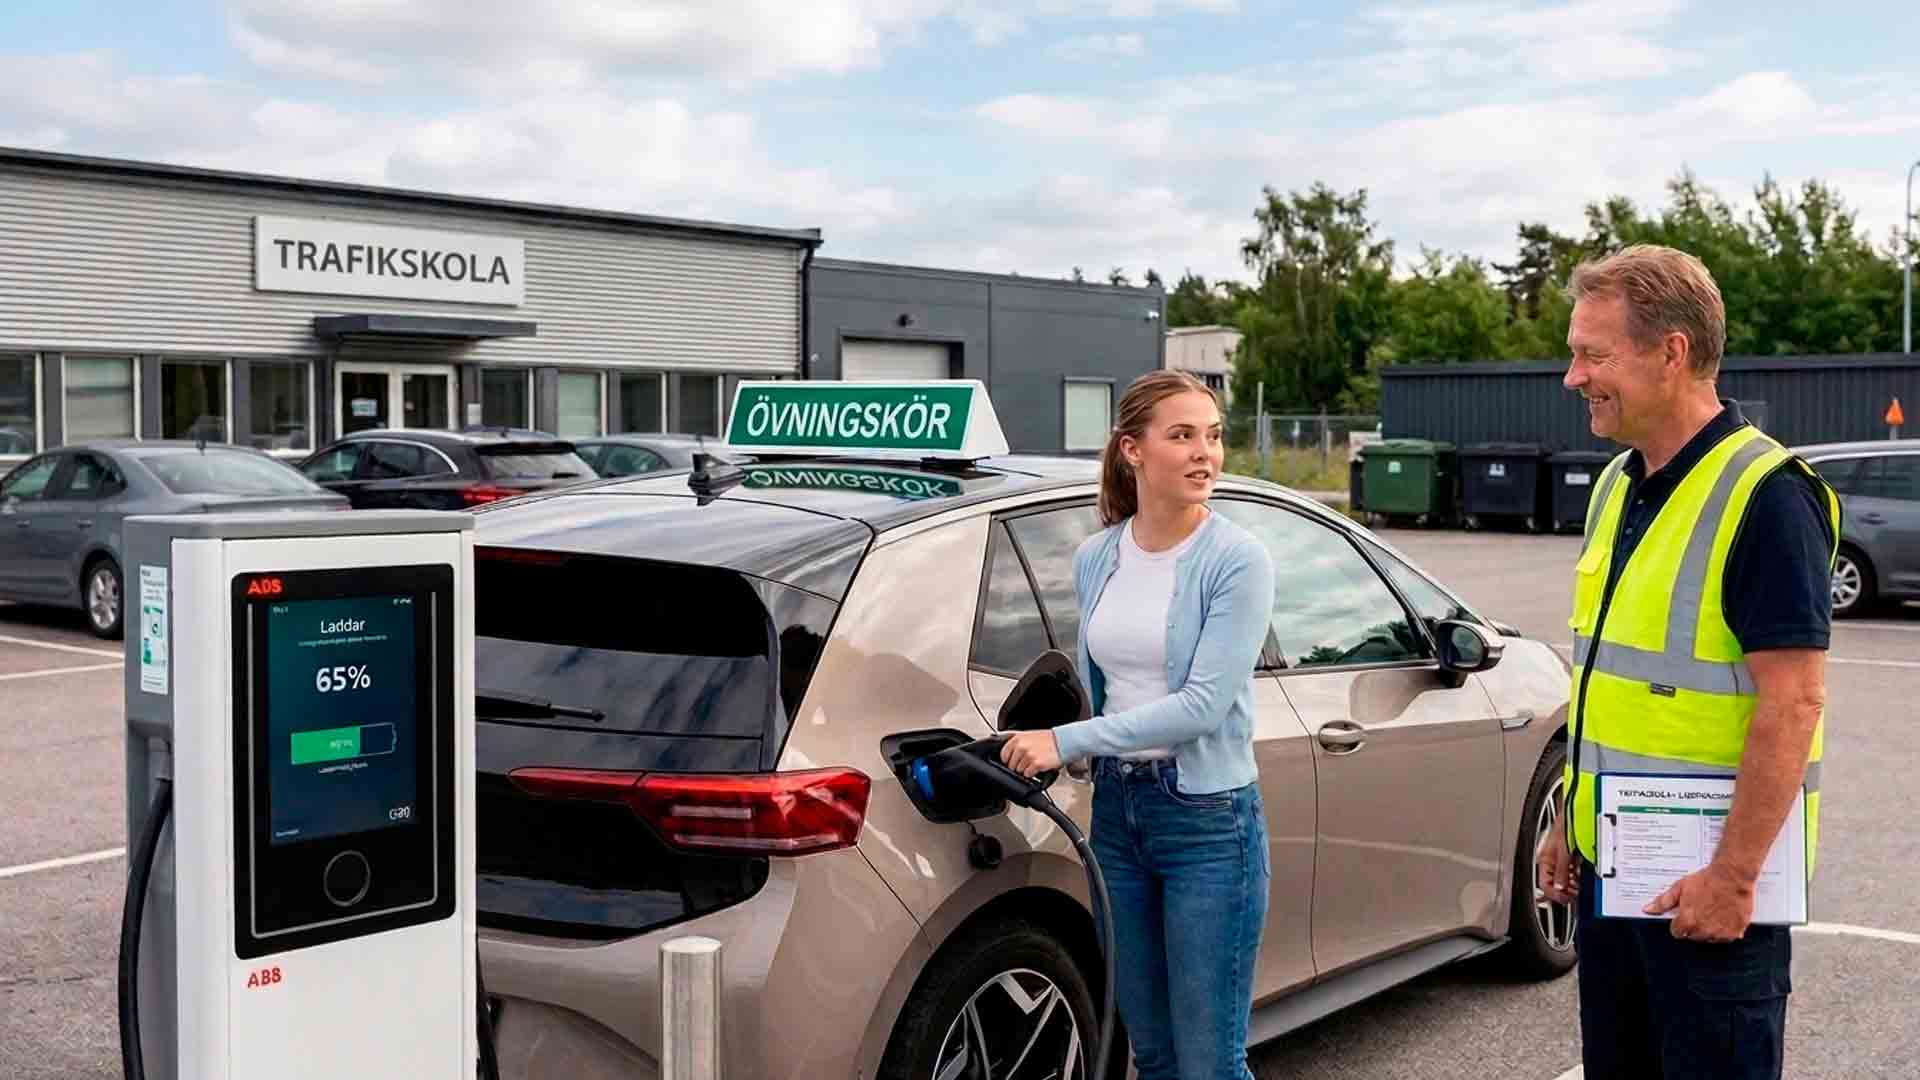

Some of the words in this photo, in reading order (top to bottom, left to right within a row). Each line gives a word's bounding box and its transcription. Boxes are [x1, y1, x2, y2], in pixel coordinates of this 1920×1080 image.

[273, 238, 511, 285] TRAFIKSKOLA
[746, 394, 952, 440] ÖVNINGSKÖR
[320, 618, 366, 634] Laddar
[315, 664, 371, 693] 65%
